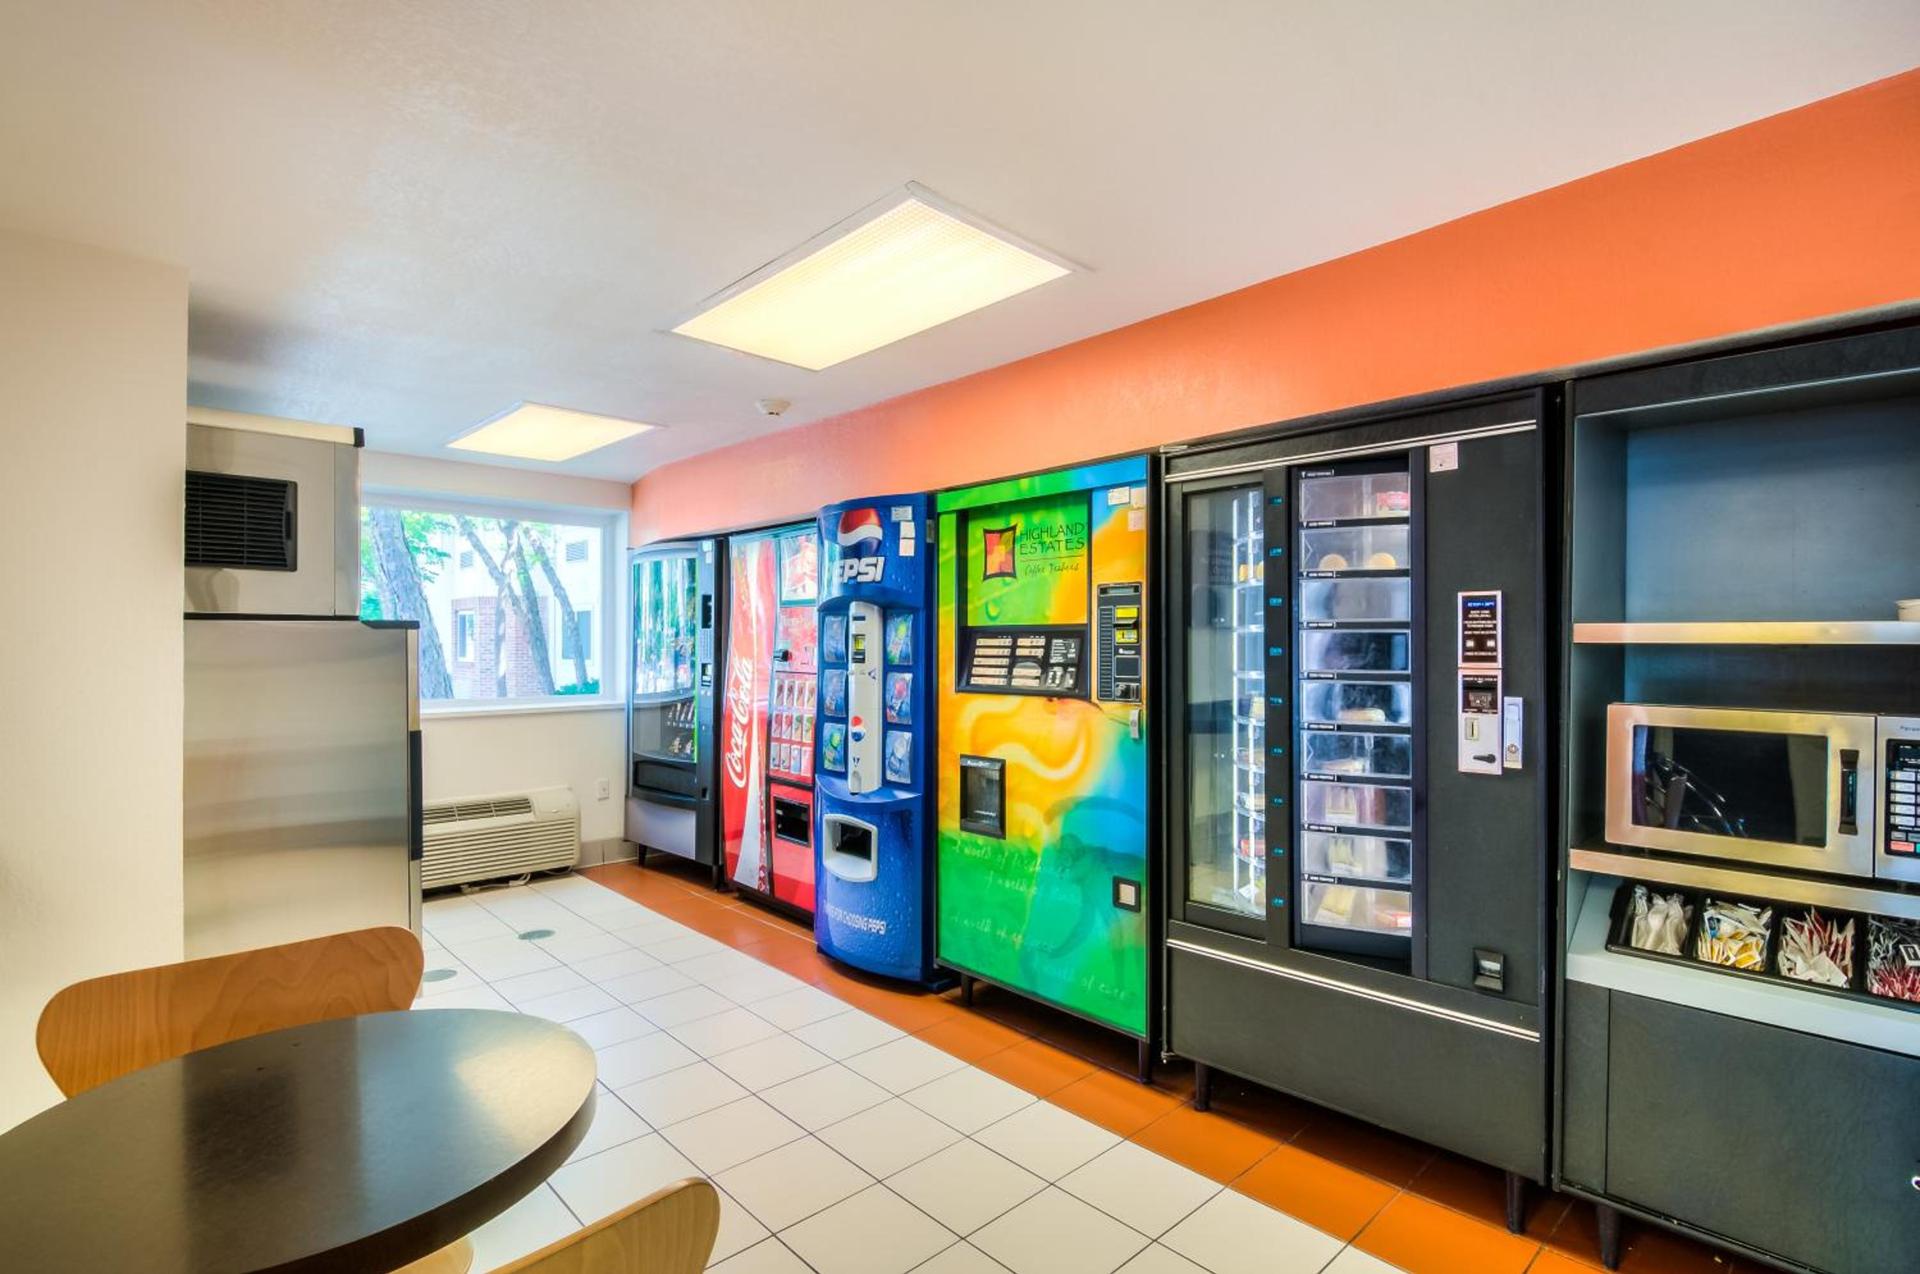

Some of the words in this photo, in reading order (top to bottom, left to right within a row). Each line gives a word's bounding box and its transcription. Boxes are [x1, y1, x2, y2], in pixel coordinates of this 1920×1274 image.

[1020, 522, 1085, 541] HIGHLAND
[1020, 537, 1085, 555] ESTATES
[726, 656, 753, 788] Coca-Cola
